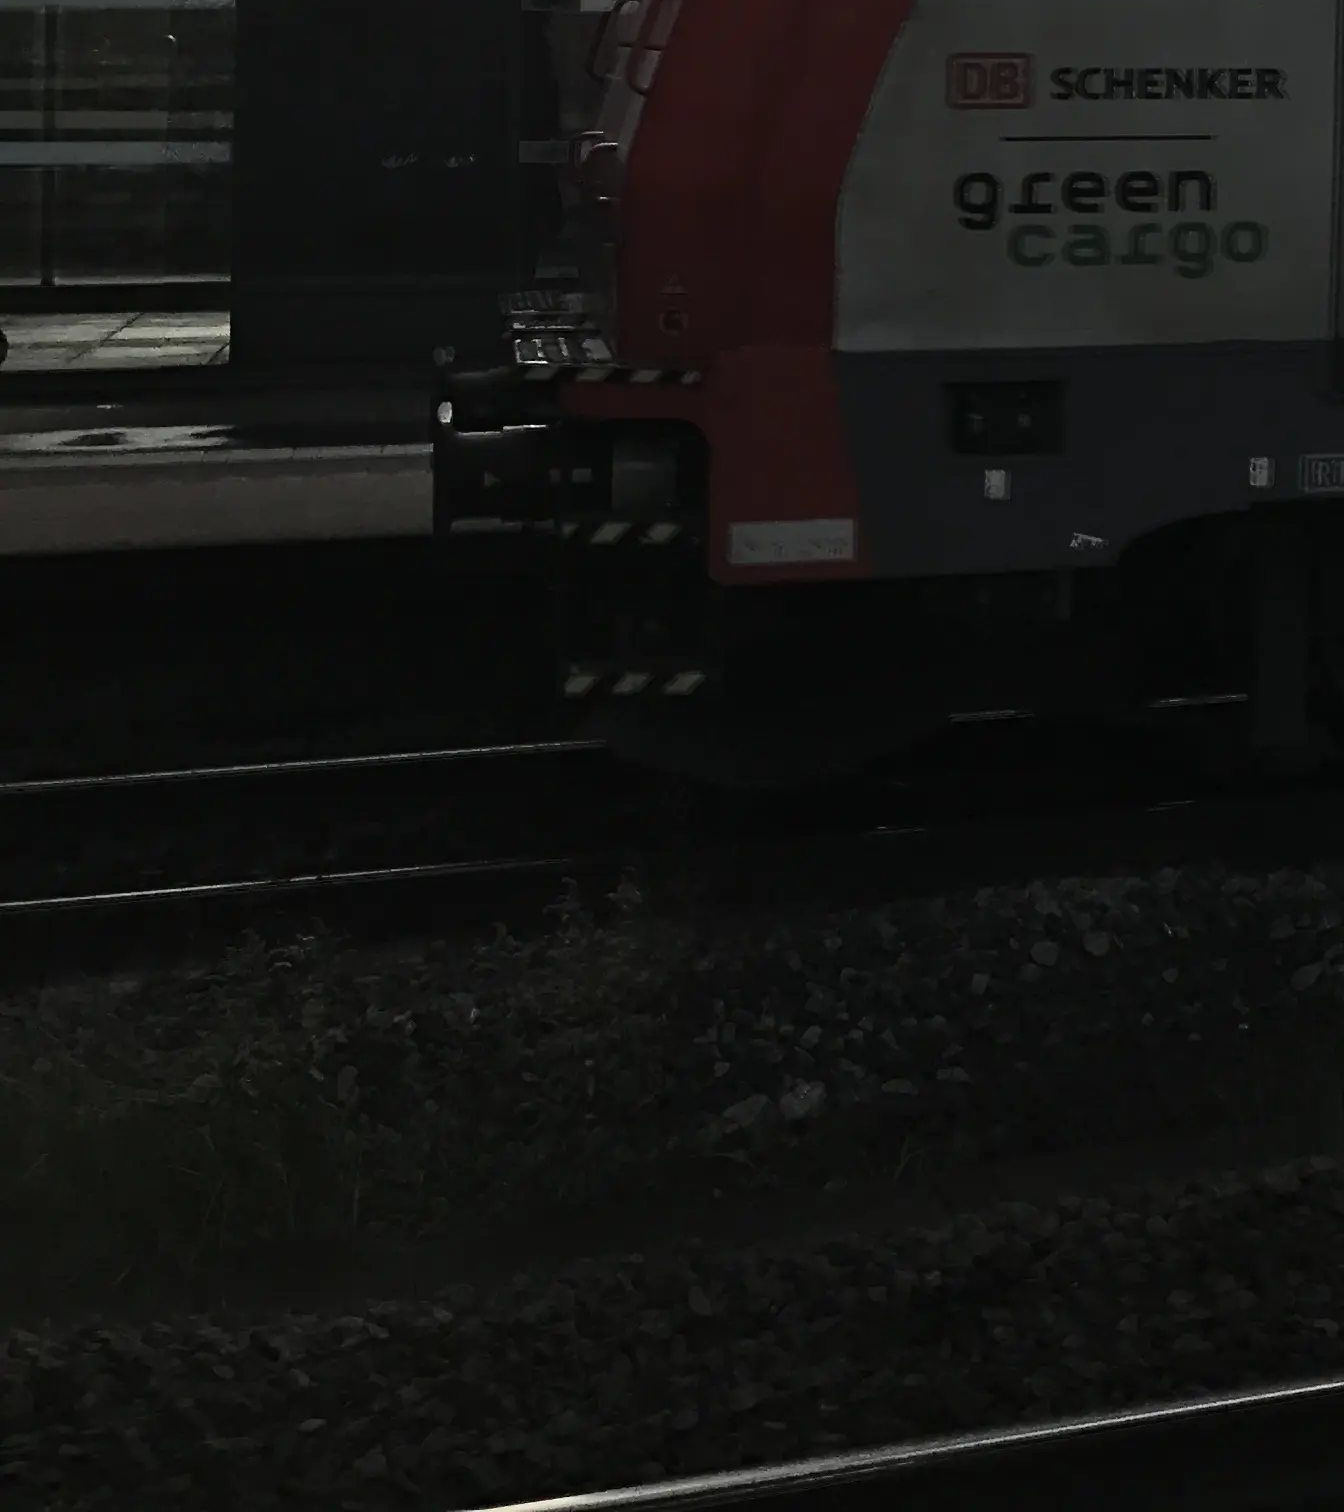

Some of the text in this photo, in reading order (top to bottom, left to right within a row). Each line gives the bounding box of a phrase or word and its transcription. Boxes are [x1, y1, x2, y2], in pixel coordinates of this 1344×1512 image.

[1049, 66, 1289, 101] SCHENKER
[953, 169, 1217, 231] green
[1006, 220, 1269, 280] cargo
